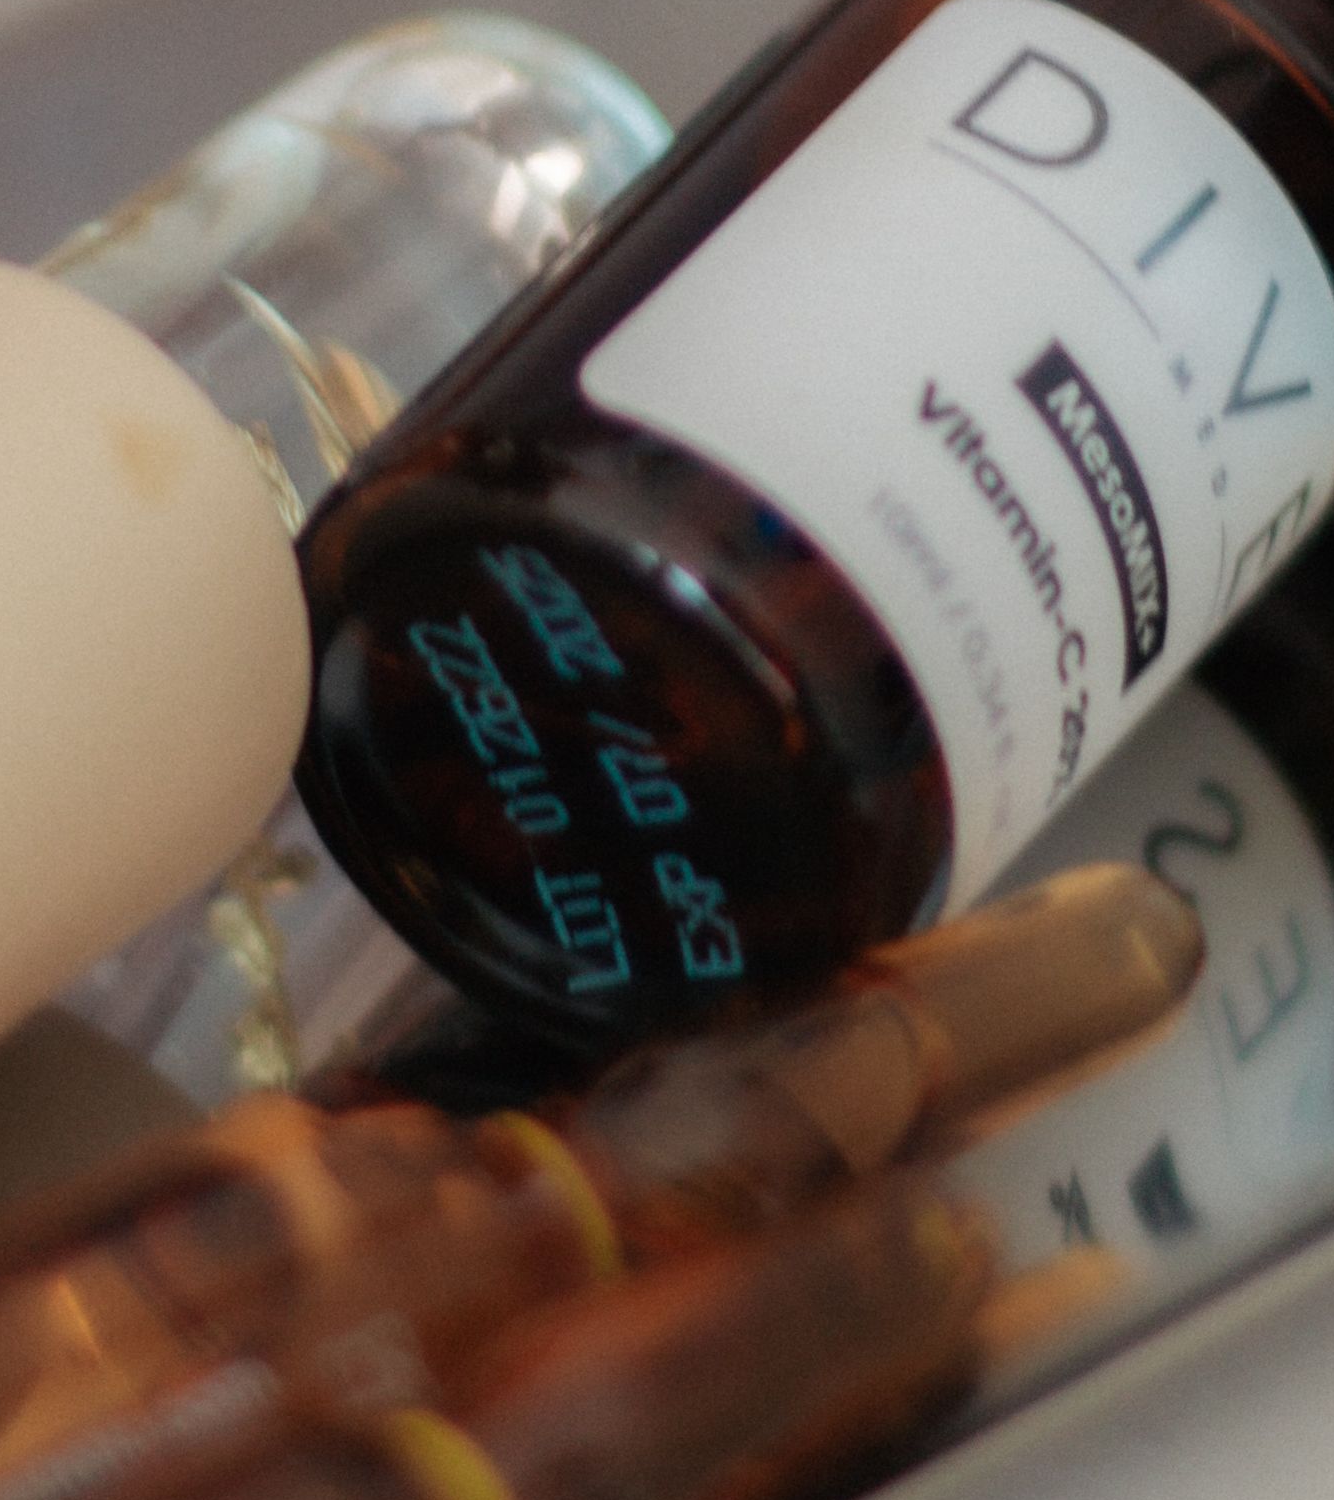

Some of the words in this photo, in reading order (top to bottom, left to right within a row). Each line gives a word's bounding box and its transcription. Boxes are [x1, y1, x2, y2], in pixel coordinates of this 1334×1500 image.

[914, 376, 1086, 686] Vitamin-C
[535, 866, 630, 993] LOT
[654, 852, 743, 981] EXP
